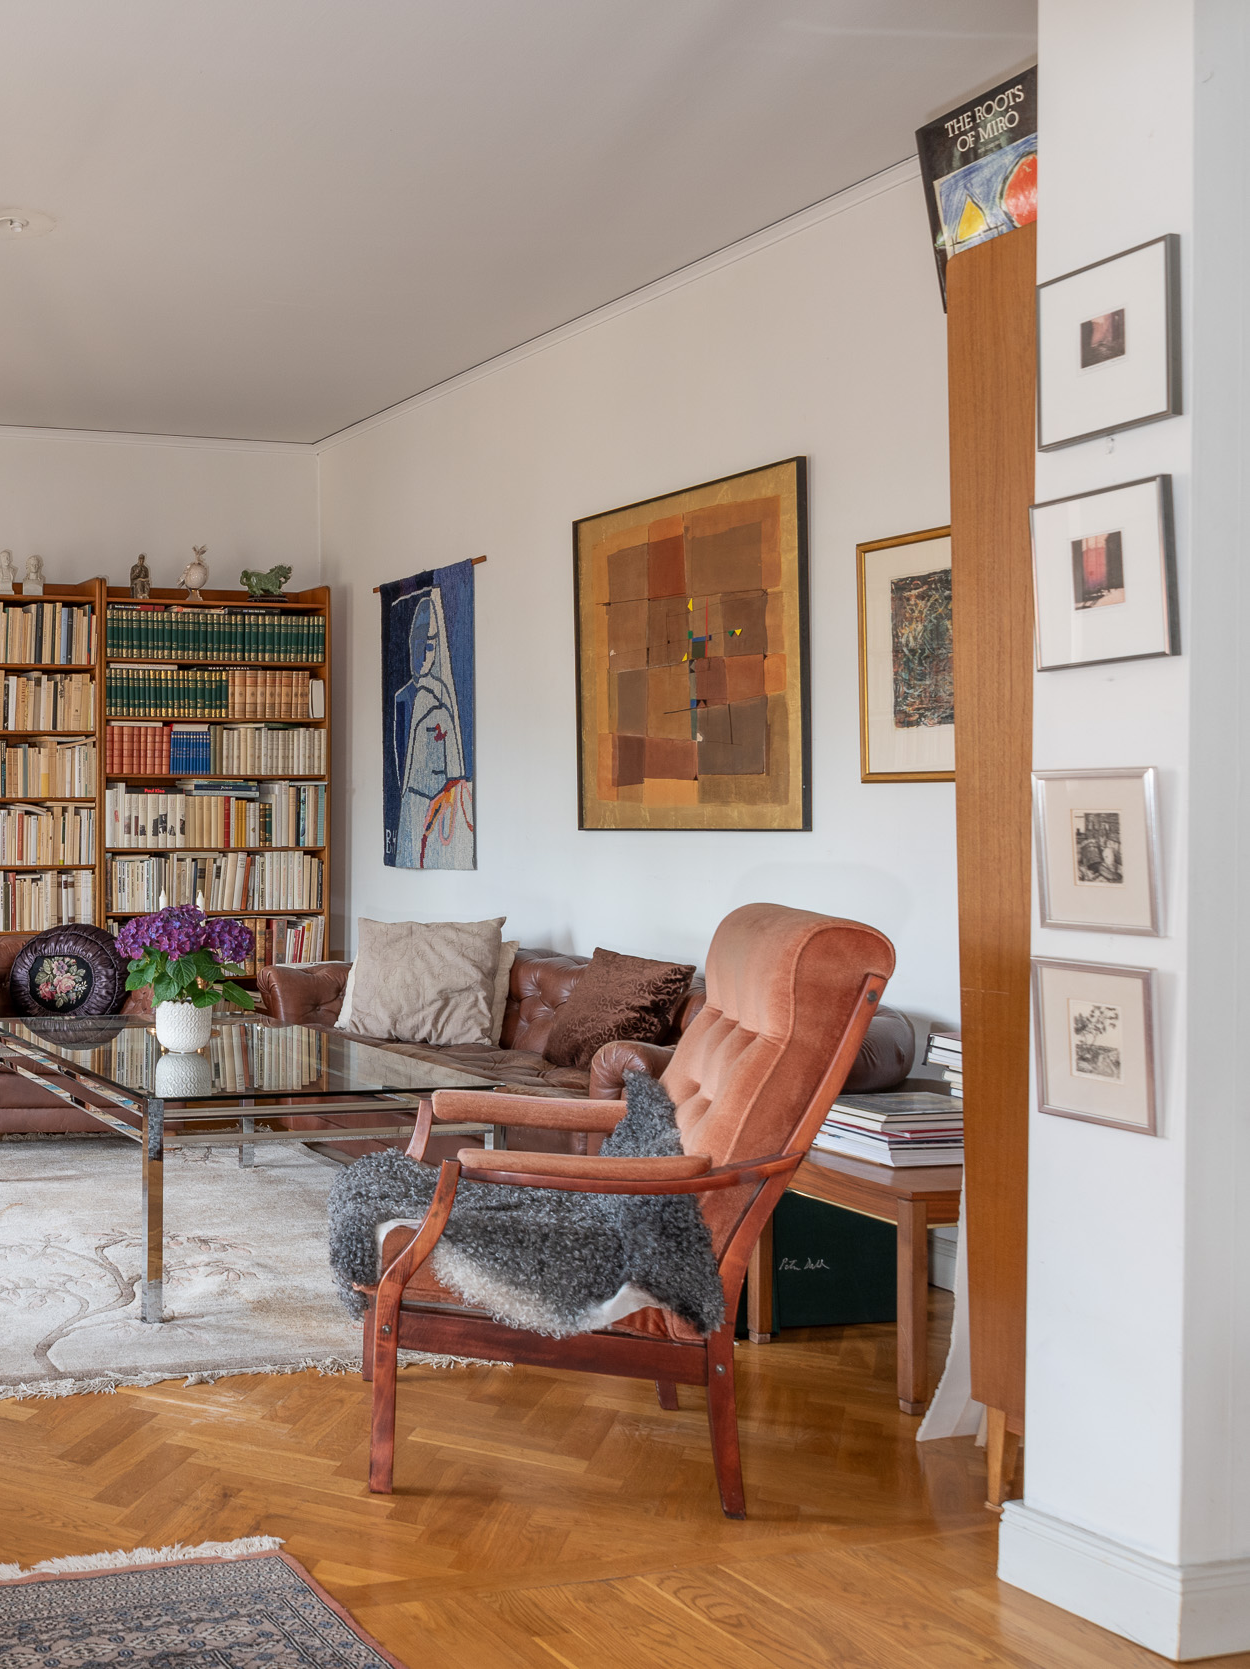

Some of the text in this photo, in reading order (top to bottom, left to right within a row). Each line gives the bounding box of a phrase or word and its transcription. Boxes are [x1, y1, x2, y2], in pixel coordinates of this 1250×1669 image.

[944, 84, 1025, 138] THE ROOTS
[956, 131, 976, 152] OF
